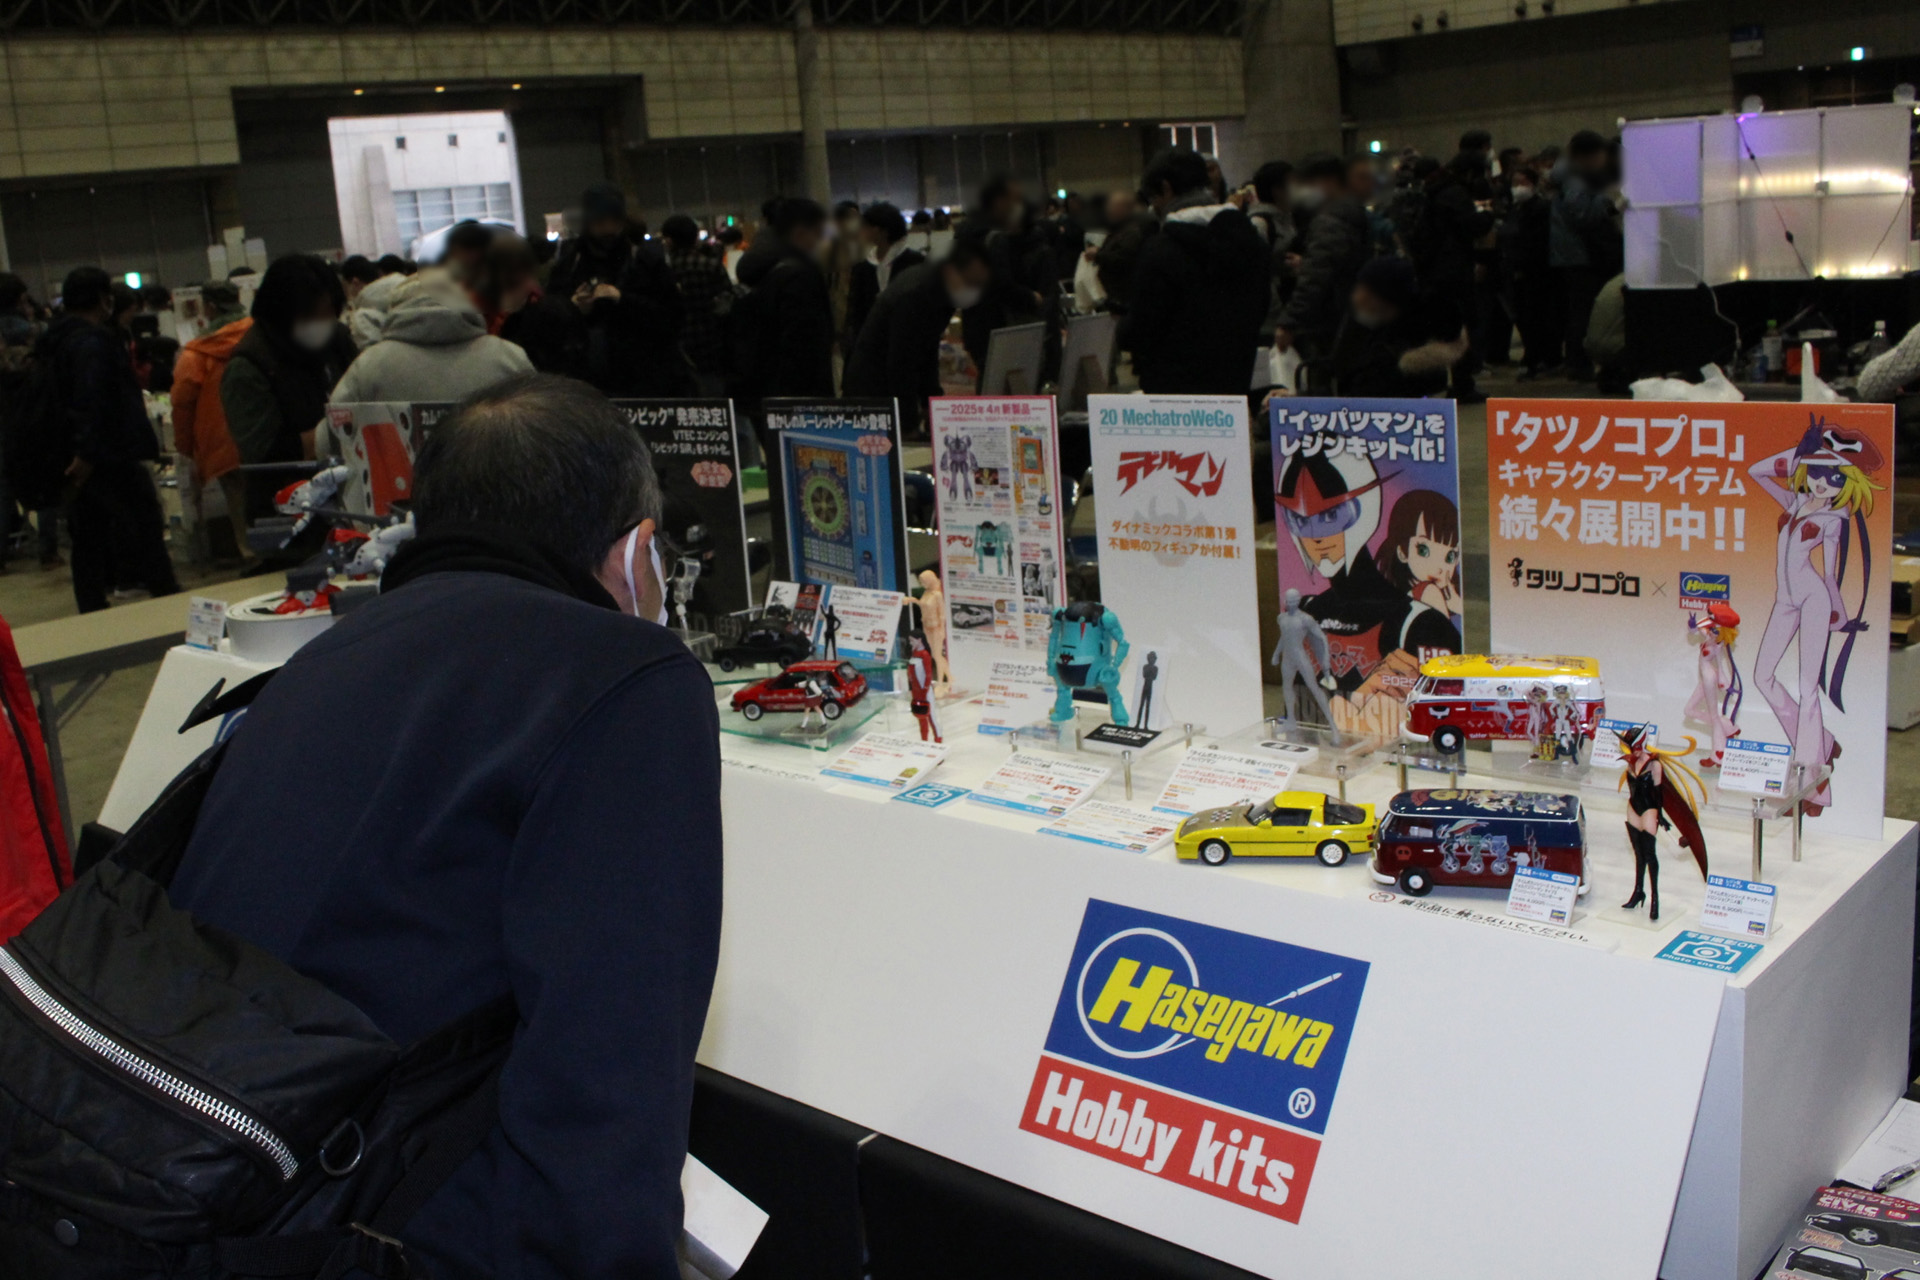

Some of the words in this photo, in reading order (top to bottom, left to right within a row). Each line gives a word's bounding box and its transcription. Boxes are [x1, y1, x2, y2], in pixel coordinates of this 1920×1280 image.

[1100, 409, 1118, 425] 20
[1122, 409, 1234, 428] MechatroWeGo
[1278, 408, 1445, 436] 「イッパツマン」を
[1496, 410, 1745, 461] 「タツノコプロ」
[1280, 435, 1446, 463] レジンキット化!
[1498, 459, 1746, 496] キャラクターアイテム
[1498, 494, 1746, 552] 続々展開中!!
[1526, 568, 1640, 597] タツノコプロ
[1088, 957, 1334, 1068] Hasegawa
[1035, 1071, 1182, 1174] Hobby
[1189, 1119, 1295, 1206] kits
